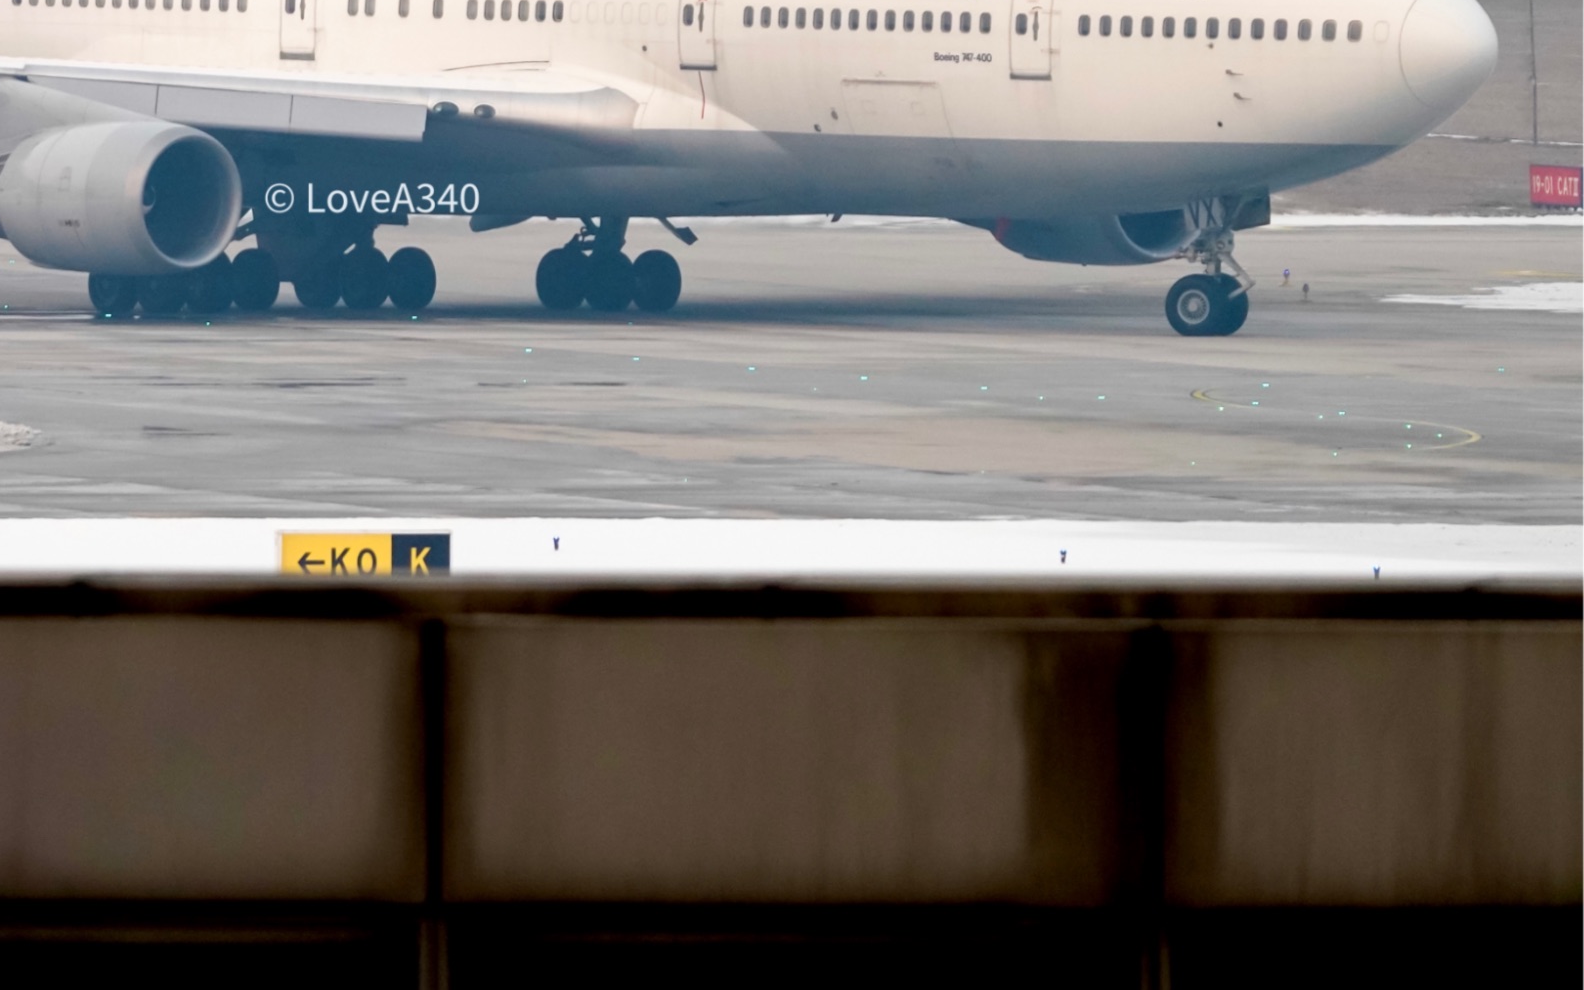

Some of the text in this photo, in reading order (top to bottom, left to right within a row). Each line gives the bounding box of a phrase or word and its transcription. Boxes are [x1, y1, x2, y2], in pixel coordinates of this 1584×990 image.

[933, 51, 960, 64] Boeing
[1532, 174, 1554, 195] 19-01
[410, 546, 431, 576] K
